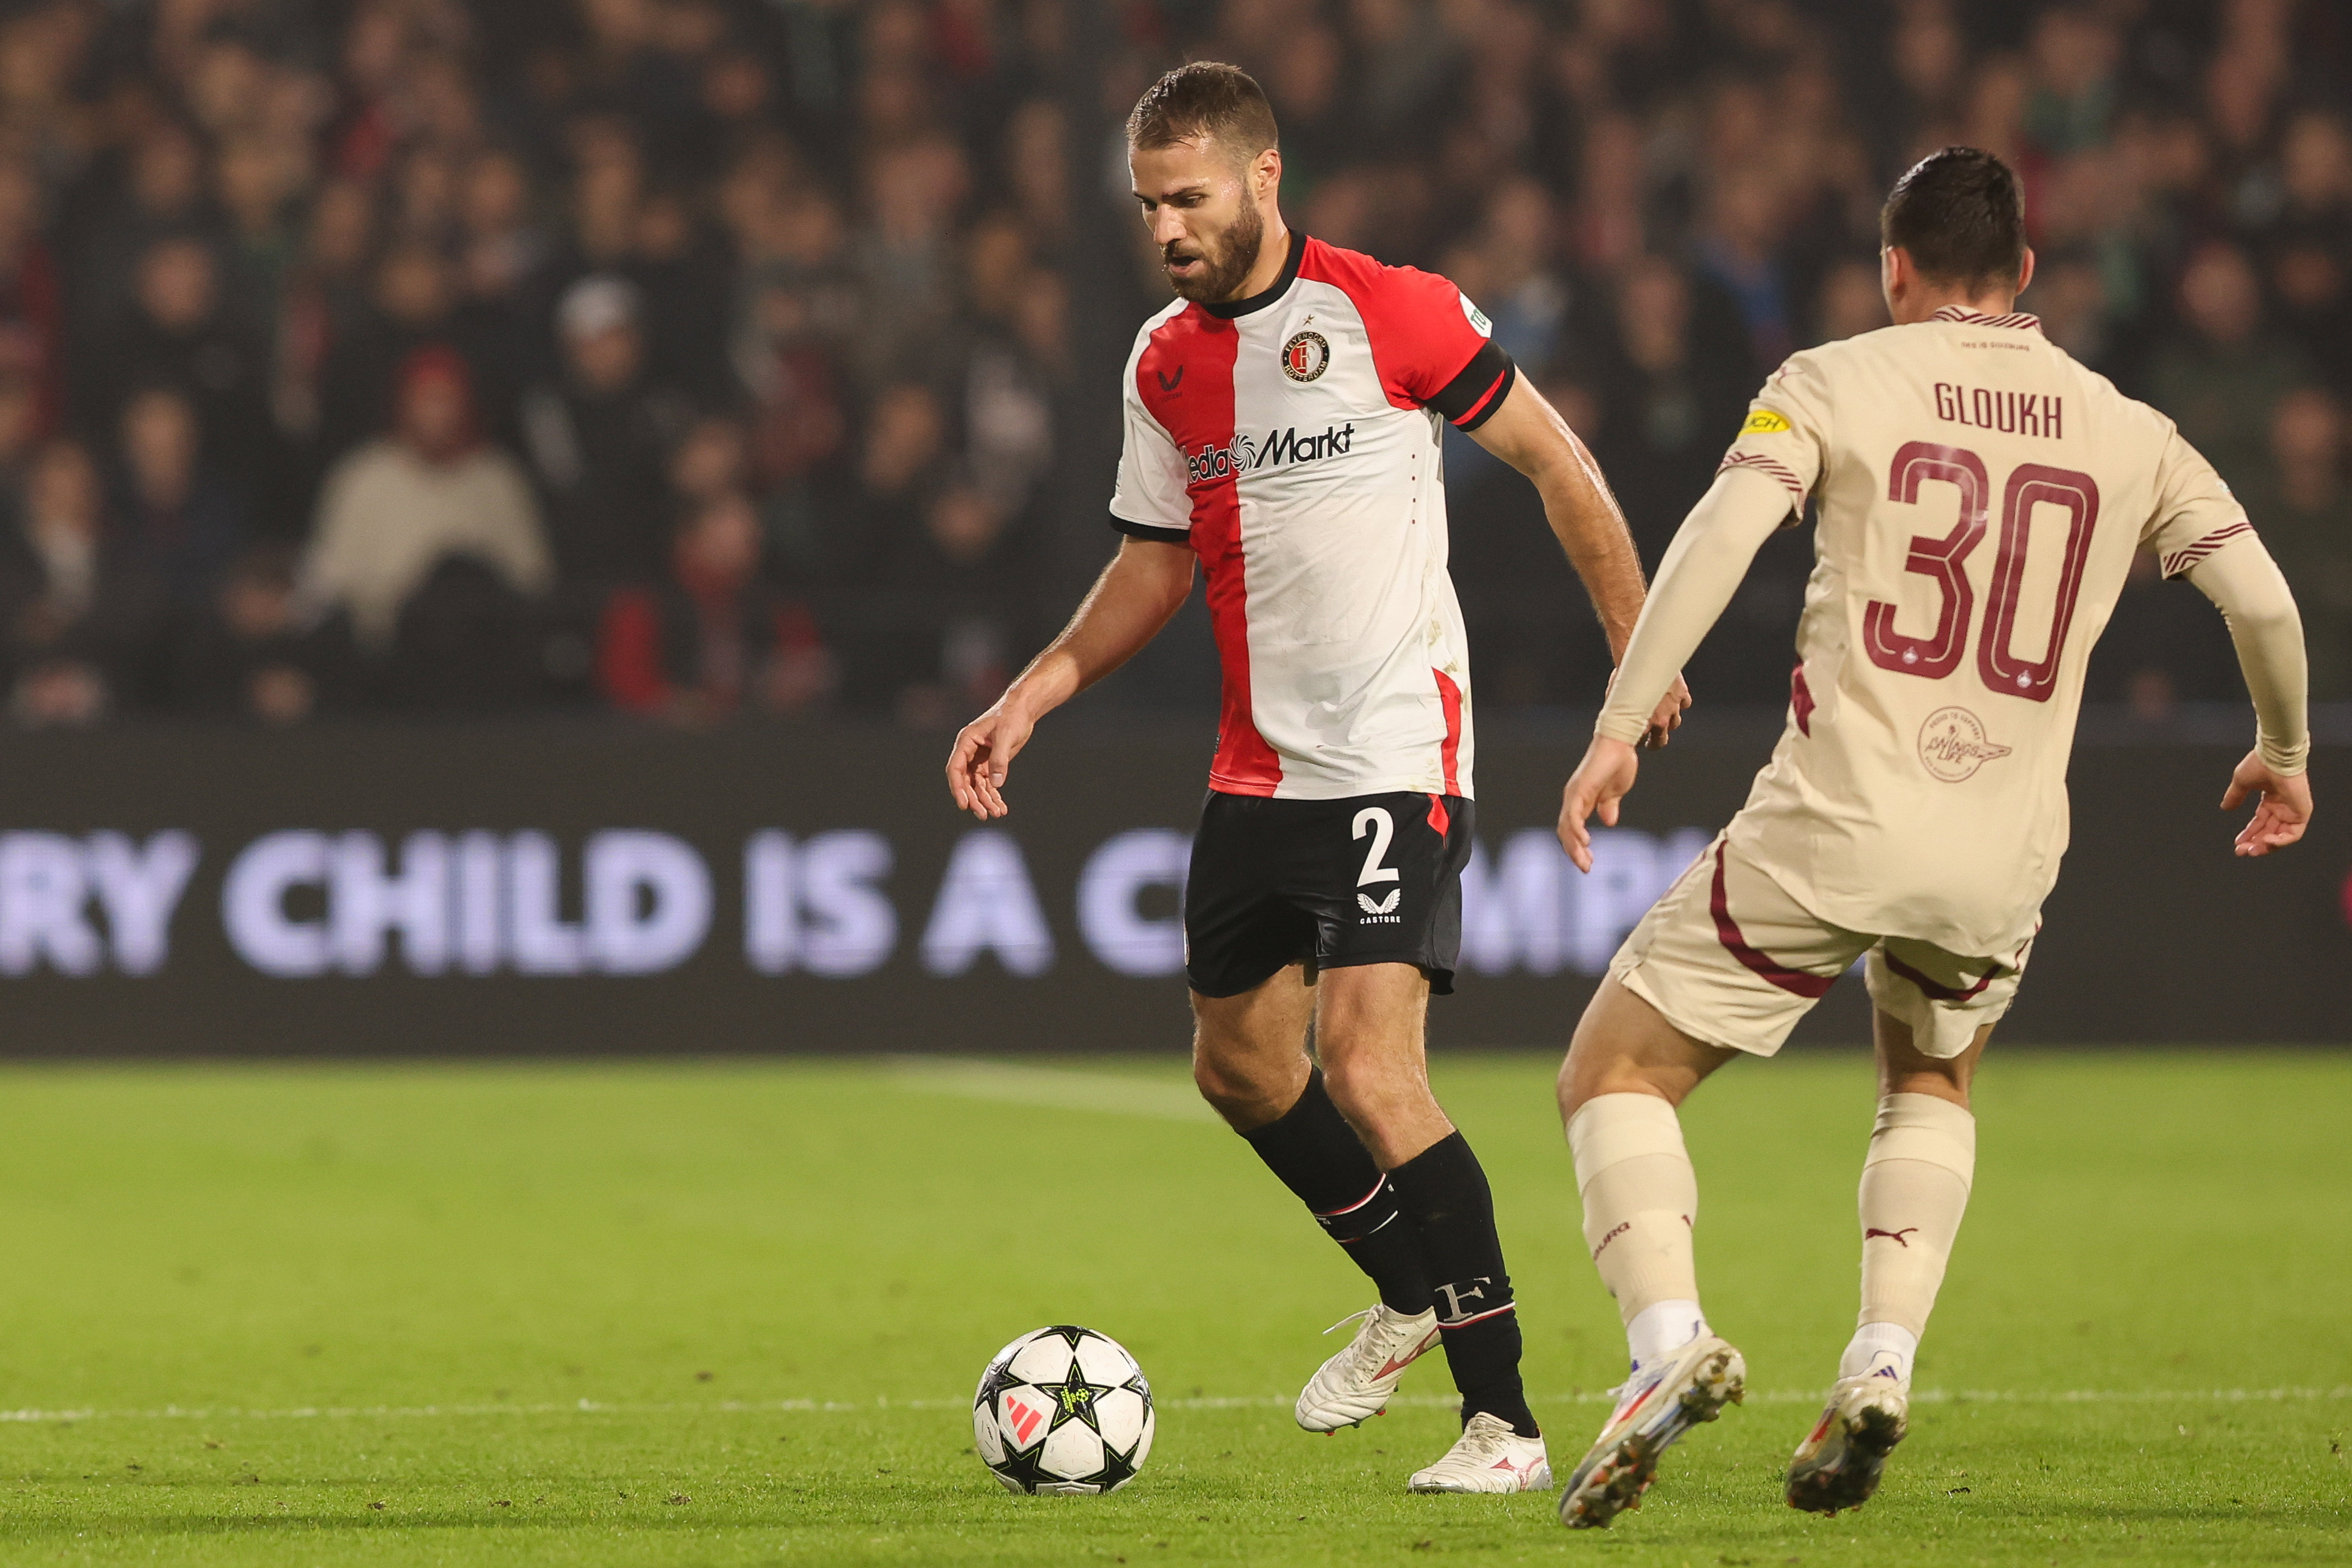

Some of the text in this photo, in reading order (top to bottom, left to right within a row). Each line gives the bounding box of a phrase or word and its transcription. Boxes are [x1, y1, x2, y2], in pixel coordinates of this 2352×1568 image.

[1285, 332, 1327, 352] FEYENOORD
[1284, 361, 1327, 382] ROTTERDAM
[1934, 382, 2062, 439] GLOUKH
[1182, 422, 1355, 483] edia Markt
[1863, 440, 2100, 703] 30
[1352, 806, 1400, 887] 2
[222, 828, 715, 979] CHILD
[742, 827, 897, 979] IS
[918, 828, 1057, 978] A
[1359, 916, 1401, 925] CASTORE
[1434, 1276, 1491, 1322] F
